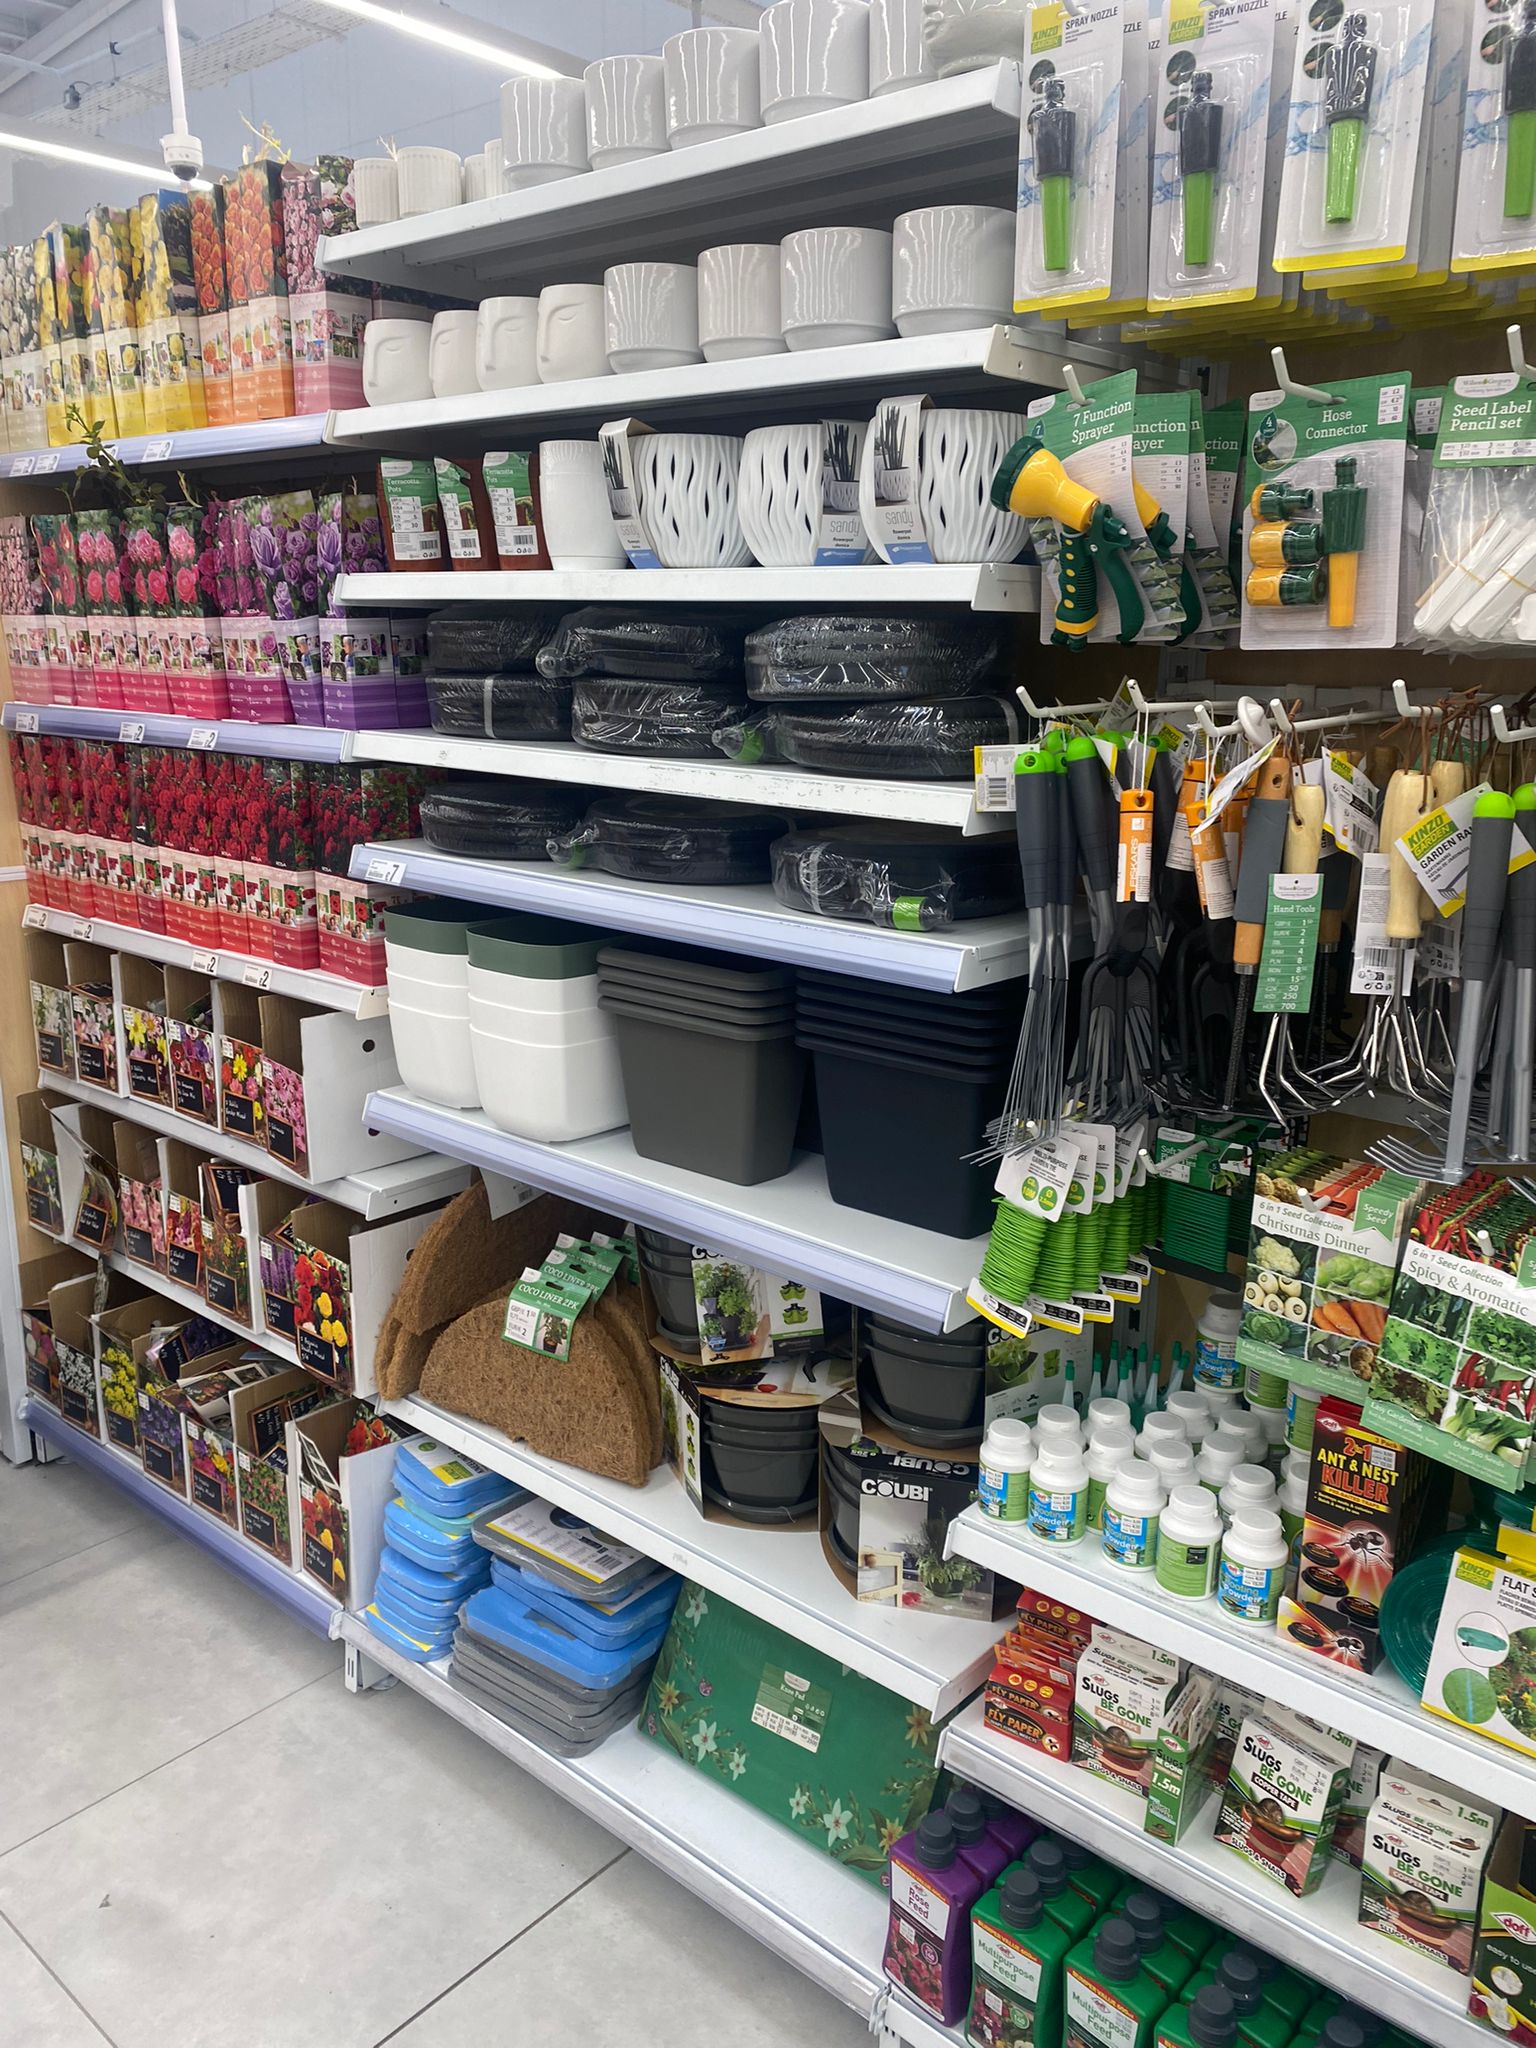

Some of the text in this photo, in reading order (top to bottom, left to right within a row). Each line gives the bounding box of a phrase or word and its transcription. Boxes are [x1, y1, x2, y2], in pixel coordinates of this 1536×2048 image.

[1065, 6, 1118, 30] SPRAY NOZZLE
[1209, 5, 1235, 21] SPRAY
[1033, 25, 1059, 41] KINZO
[1171, 17, 1200, 32] KINZO
[1073, 401, 1132, 427] 7 Function
[1322, 409, 1352, 423] Hose
[1453, 400, 1532, 417] Seed Label
[1035, 424, 1042, 435] 7
[1265, 416, 1273, 427] 4
[1305, 423, 1368, 440] Connector
[1450, 416, 1523, 432] Pencil set
[1071, 422, 1115, 444] Sprayer
[386, 478, 420, 486] Terracotta
[387, 486, 402, 494] Pots
[830, 518, 861, 537] sandy
[885, 507, 914, 527] sandy
[1408, 814, 1444, 848] KINZO
[1414, 825, 1450, 856] GARDEN
[1129, 837, 1139, 888] FISKARS
[1420, 837, 1457, 869] GARDEN
[1273, 905, 1316, 913] Hand Tools
[1300, 928, 1306, 936] 2
[1298, 947, 1304, 955] 4
[206, 956, 217, 973] £2
[259, 970, 270, 988] £2
[1288, 984, 1299, 992] 50
[1280, 1002, 1297, 1010] 700
[1282, 992, 1298, 1000] 250
[1259, 1201, 1344, 1231] 6 in 1 Seed Collection
[1363, 1203, 1394, 1218] Speedy
[1366, 1213, 1388, 1225] Seed
[1257, 1213, 1371, 1256] Christmas Dinner
[544, 1265, 564, 1279] COCO
[562, 1272, 586, 1286] LINER
[1412, 1247, 1504, 1288] 6 in 1 Seed Collection
[518, 1283, 580, 1310] COCO LINER 2PK
[1408, 1260, 1529, 1317] Spicy & Aromatic
[521, 1327, 528, 1337] 2
[1370, 1401, 1385, 1414] Easy
[1387, 1408, 1424, 1432] Gardening
[1453, 1440, 1467, 1451] Over
[893, 1455, 970, 1475] COUBI
[1317, 1448, 1399, 1486] ANT & NEST
[861, 1478, 929, 1501] COUBI
[1321, 1464, 1389, 1505] KILLER
[1034, 1511, 1068, 1527] Powder
[1106, 1533, 1139, 1550] Powder
[1459, 1560, 1491, 1578] KINZO
[1224, 1584, 1262, 1603] Powder
[1502, 1575, 1531, 1594] FLAT
[1020, 1611, 1067, 1635] FLY PAPER
[1092, 1647, 1116, 1661] SLUGS
[1126, 1662, 1149, 1675] GONE
[1151, 1649, 1176, 1668] 1.5m
[780, 1683, 806, 1701] Knee Pad
[991, 1685, 1038, 1710] FLY PAPER
[1082, 1676, 1120, 1704] SLUGS
[988, 1707, 1042, 1739] FLY PAPER
[1100, 1698, 1153, 1728] BE GONE
[1156, 1748, 1184, 1769] SLUGS
[1242, 1736, 1283, 1773] SLUGS
[1088, 1761, 1113, 1778] SLUGS
[1117, 1775, 1143, 1792] SNAILS
[1164, 1761, 1184, 1775] GONE
[1152, 1771, 1181, 1796] 1.5m
[1253, 1775, 1298, 1808] COPPER TAPE
[1259, 1763, 1275, 1781] BE
[1276, 1774, 1313, 1807] GONE
[1381, 1801, 1454, 1836] SLUGS BE GONE
[1457, 1806, 1489, 1828] 1.5m
[1231, 1836, 1255, 1856] SLUGS
[1260, 1858, 1286, 1880] SNAILS
[1372, 1834, 1422, 1868] SLUGS
[1392, 1869, 1447, 1902] COPPER TAPE
[1397, 1859, 1463, 1897] BE GONE
[908, 1887, 930, 1910] Rose
[908, 1897, 929, 1920] Feed
[1503, 1917, 1531, 1937] doff
[1379, 1922, 1408, 1941] SLUGS
[1417, 1942, 1448, 1962] SNAILS
[978, 1939, 1035, 1982] Multipurpose
[1486, 1944, 1520, 1966] easy to
[992, 1960, 1017, 1983] Feed
[1072, 1990, 1131, 2041] Multipurpose
[1087, 2016, 1112, 2040] Feed
